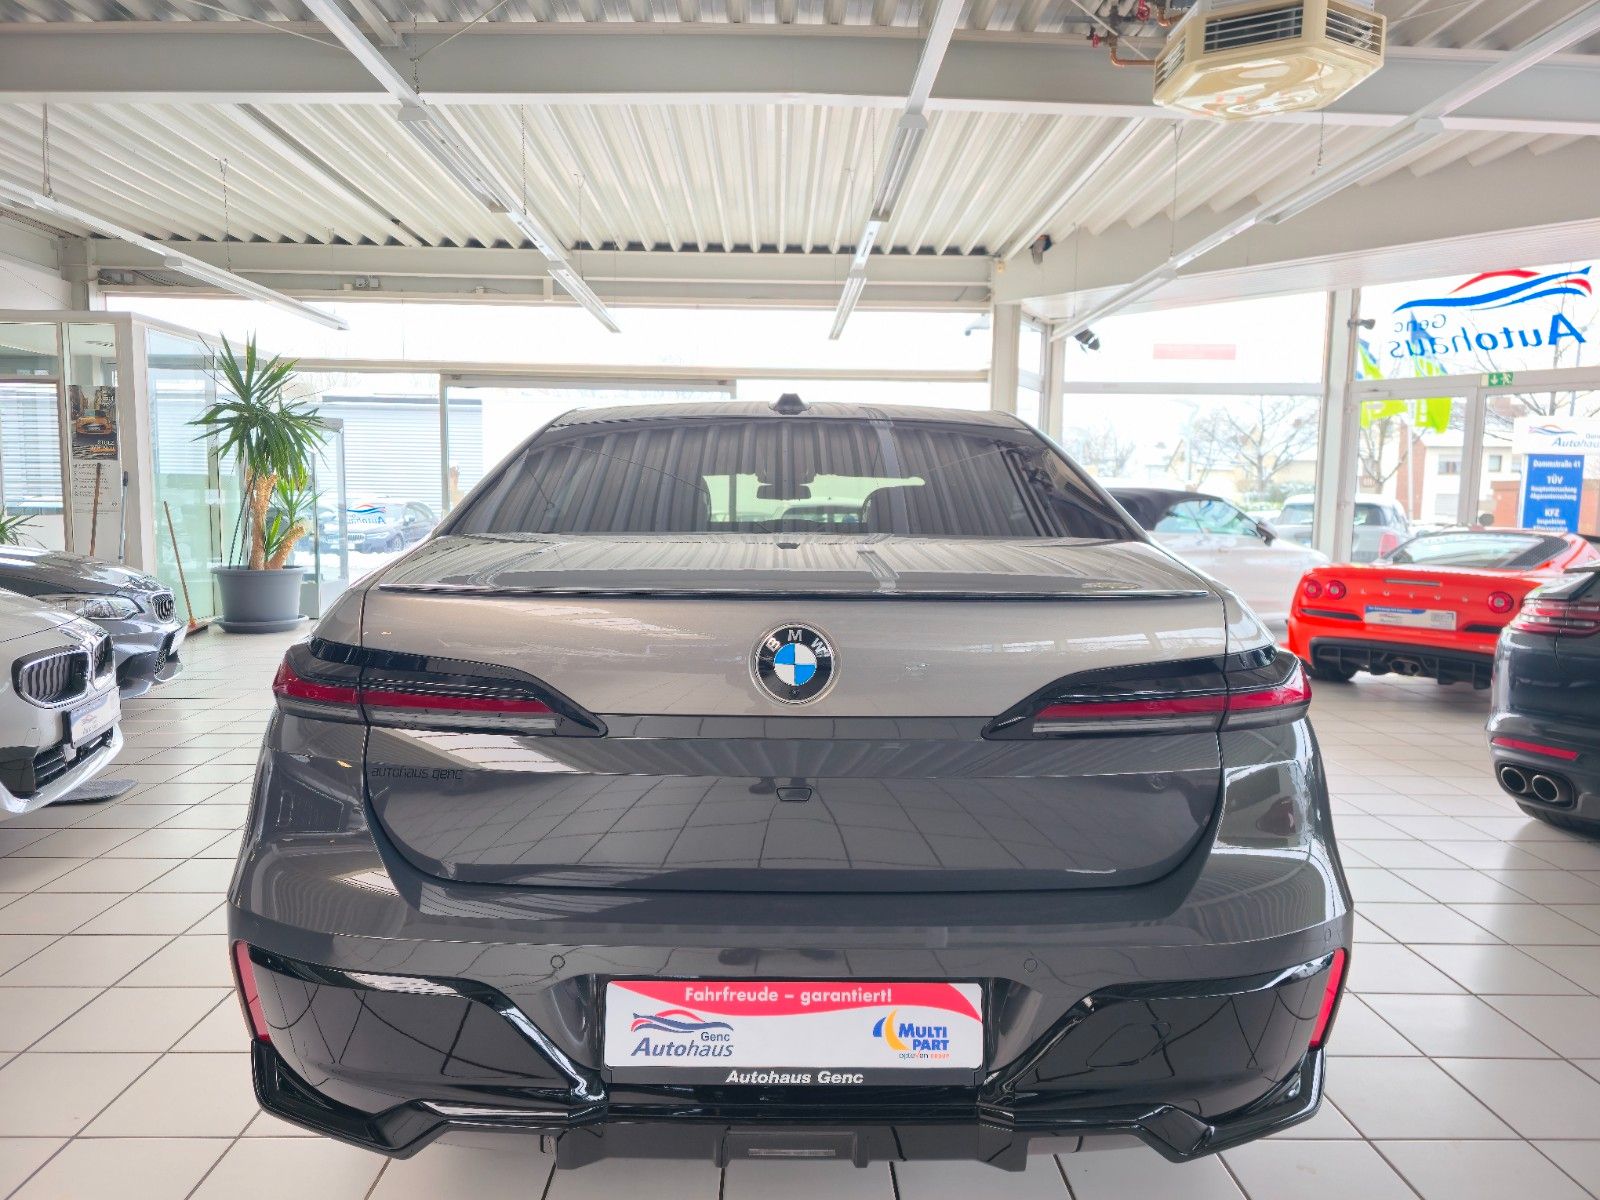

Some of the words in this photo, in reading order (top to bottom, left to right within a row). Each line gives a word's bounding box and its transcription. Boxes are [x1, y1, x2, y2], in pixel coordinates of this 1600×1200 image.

[1551, 437, 1600, 449] Autohau
[1547, 474, 1563, 484] TÜV
[766, 630, 832, 657] BMW
[371, 766, 429, 778] autohaus
[432, 769, 462, 781] genc
[685, 986, 778, 1002] Fahrfreude
[801, 987, 892, 1005] garantiert!
[701, 1031, 730, 1042] Genc
[631, 1037, 734, 1057] Autohaus
[912, 1039, 950, 1051] PART
[725, 1070, 812, 1084] Autohaus
[817, 1070, 864, 1084] Genc
